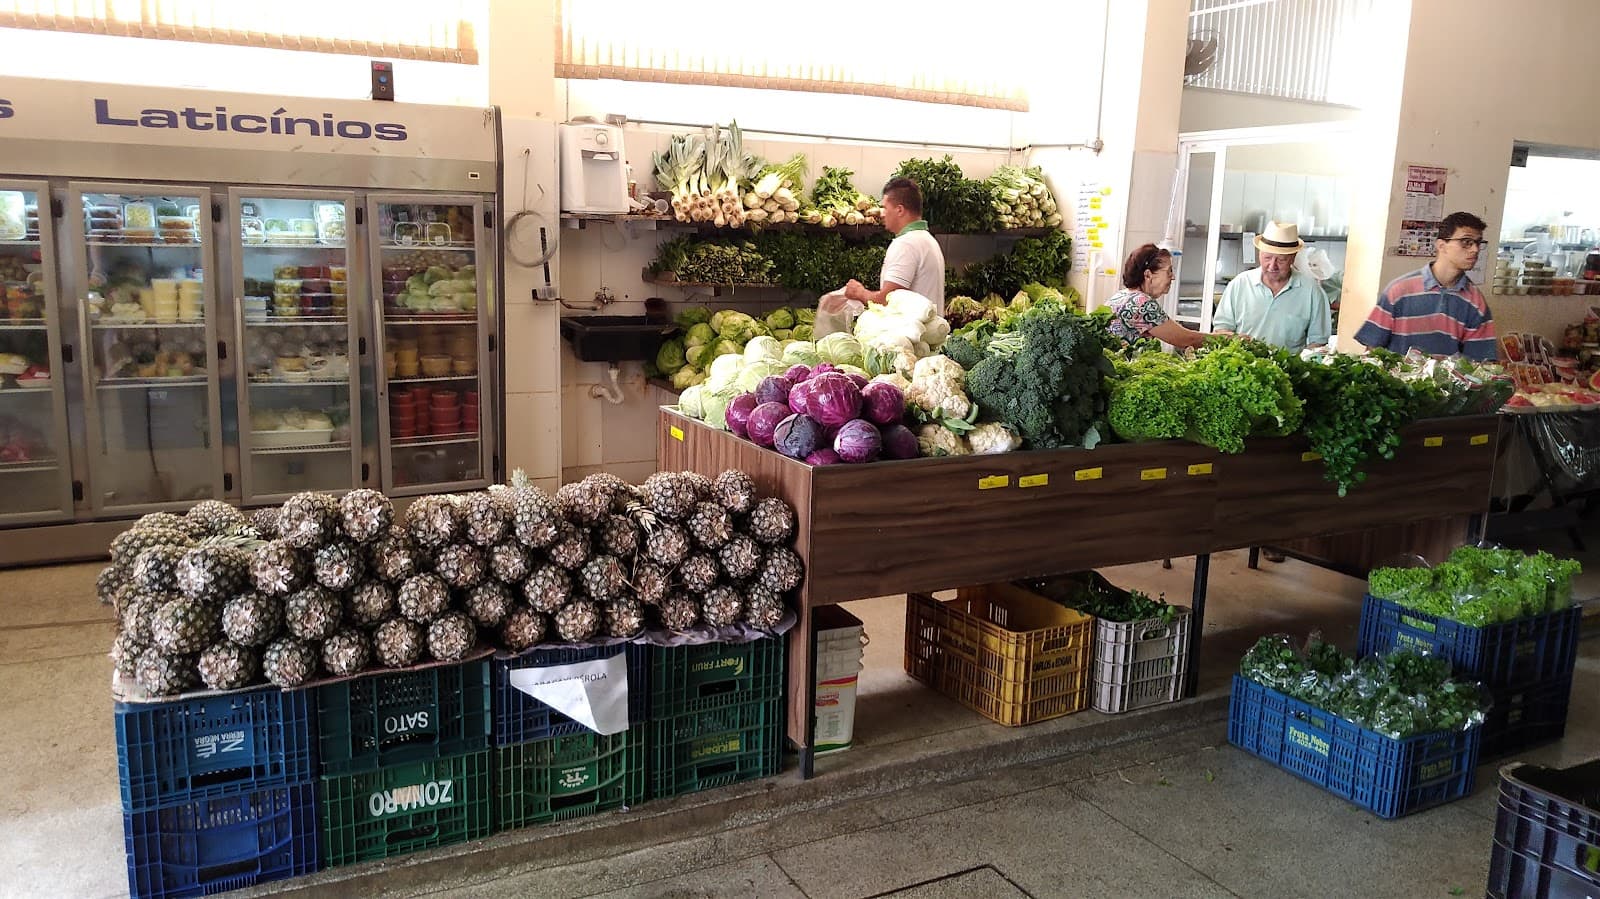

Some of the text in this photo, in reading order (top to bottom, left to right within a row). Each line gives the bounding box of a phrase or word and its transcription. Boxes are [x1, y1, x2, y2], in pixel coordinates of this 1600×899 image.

[95, 97, 408, 142] Laticínios
[384, 710, 429, 734] SATO
[1289, 726, 1330, 751] Fruta Nobre
